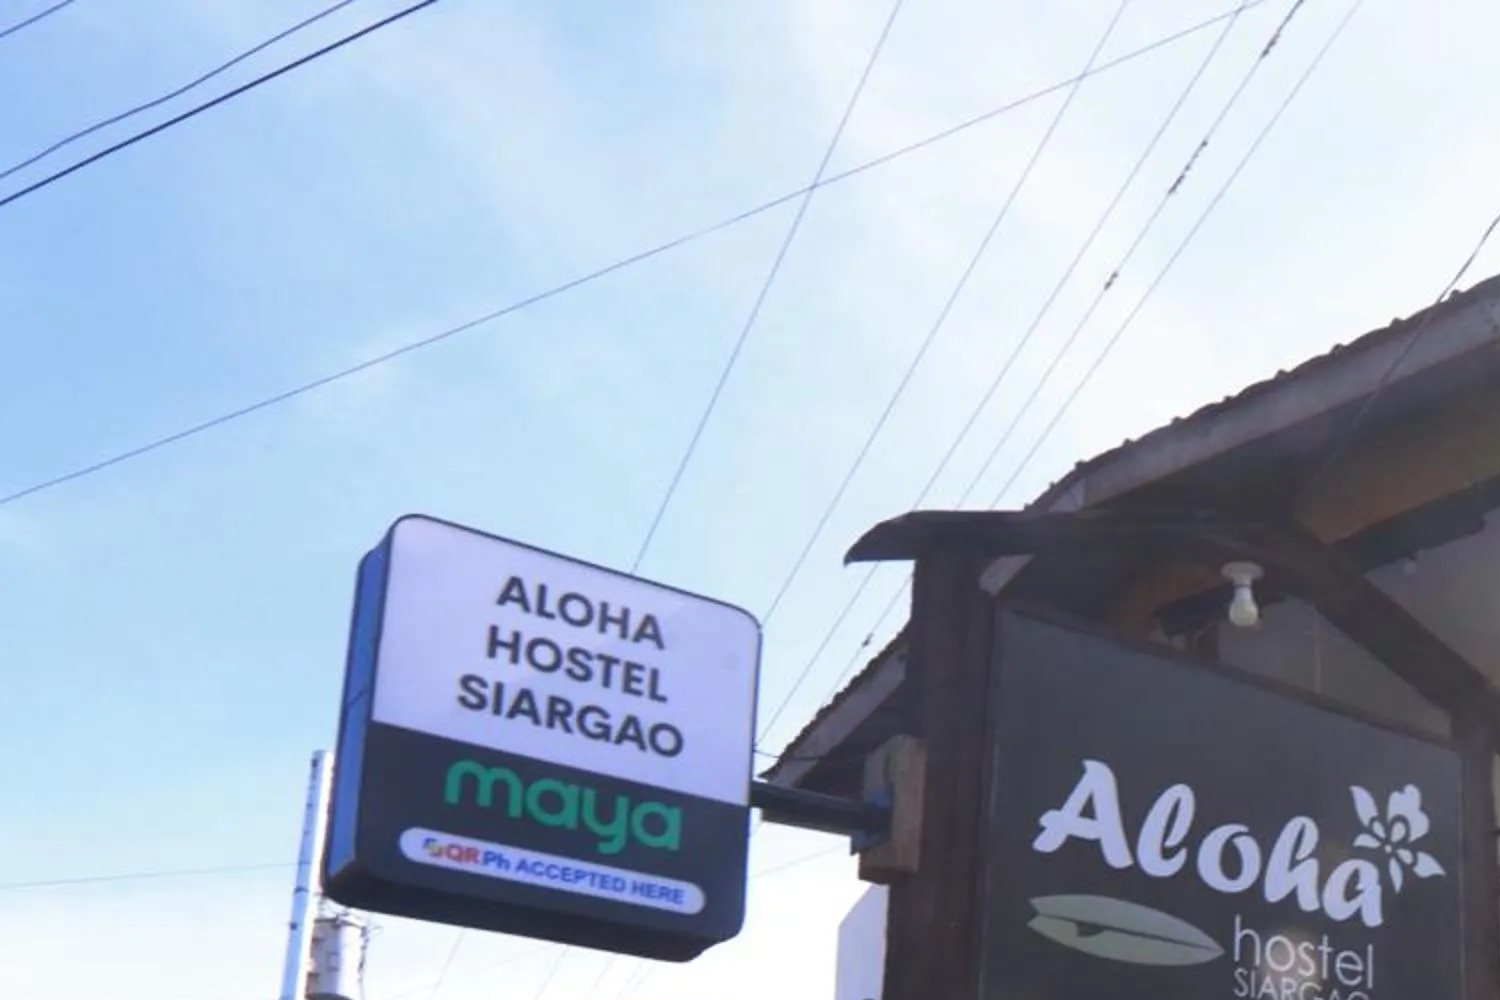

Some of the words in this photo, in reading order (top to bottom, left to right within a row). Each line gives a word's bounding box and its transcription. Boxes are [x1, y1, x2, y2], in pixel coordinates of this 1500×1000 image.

[496, 576, 666, 650] ALOHA
[486, 625, 669, 703] HOSTEL
[456, 673, 685, 759] SIARGAO
[444, 759, 681, 855] maya
[1031, 759, 1384, 928] Aloha
[515, 858, 627, 893] ACCEPTED
[631, 879, 686, 905] HERE
[1233, 914, 1374, 989] hostel
